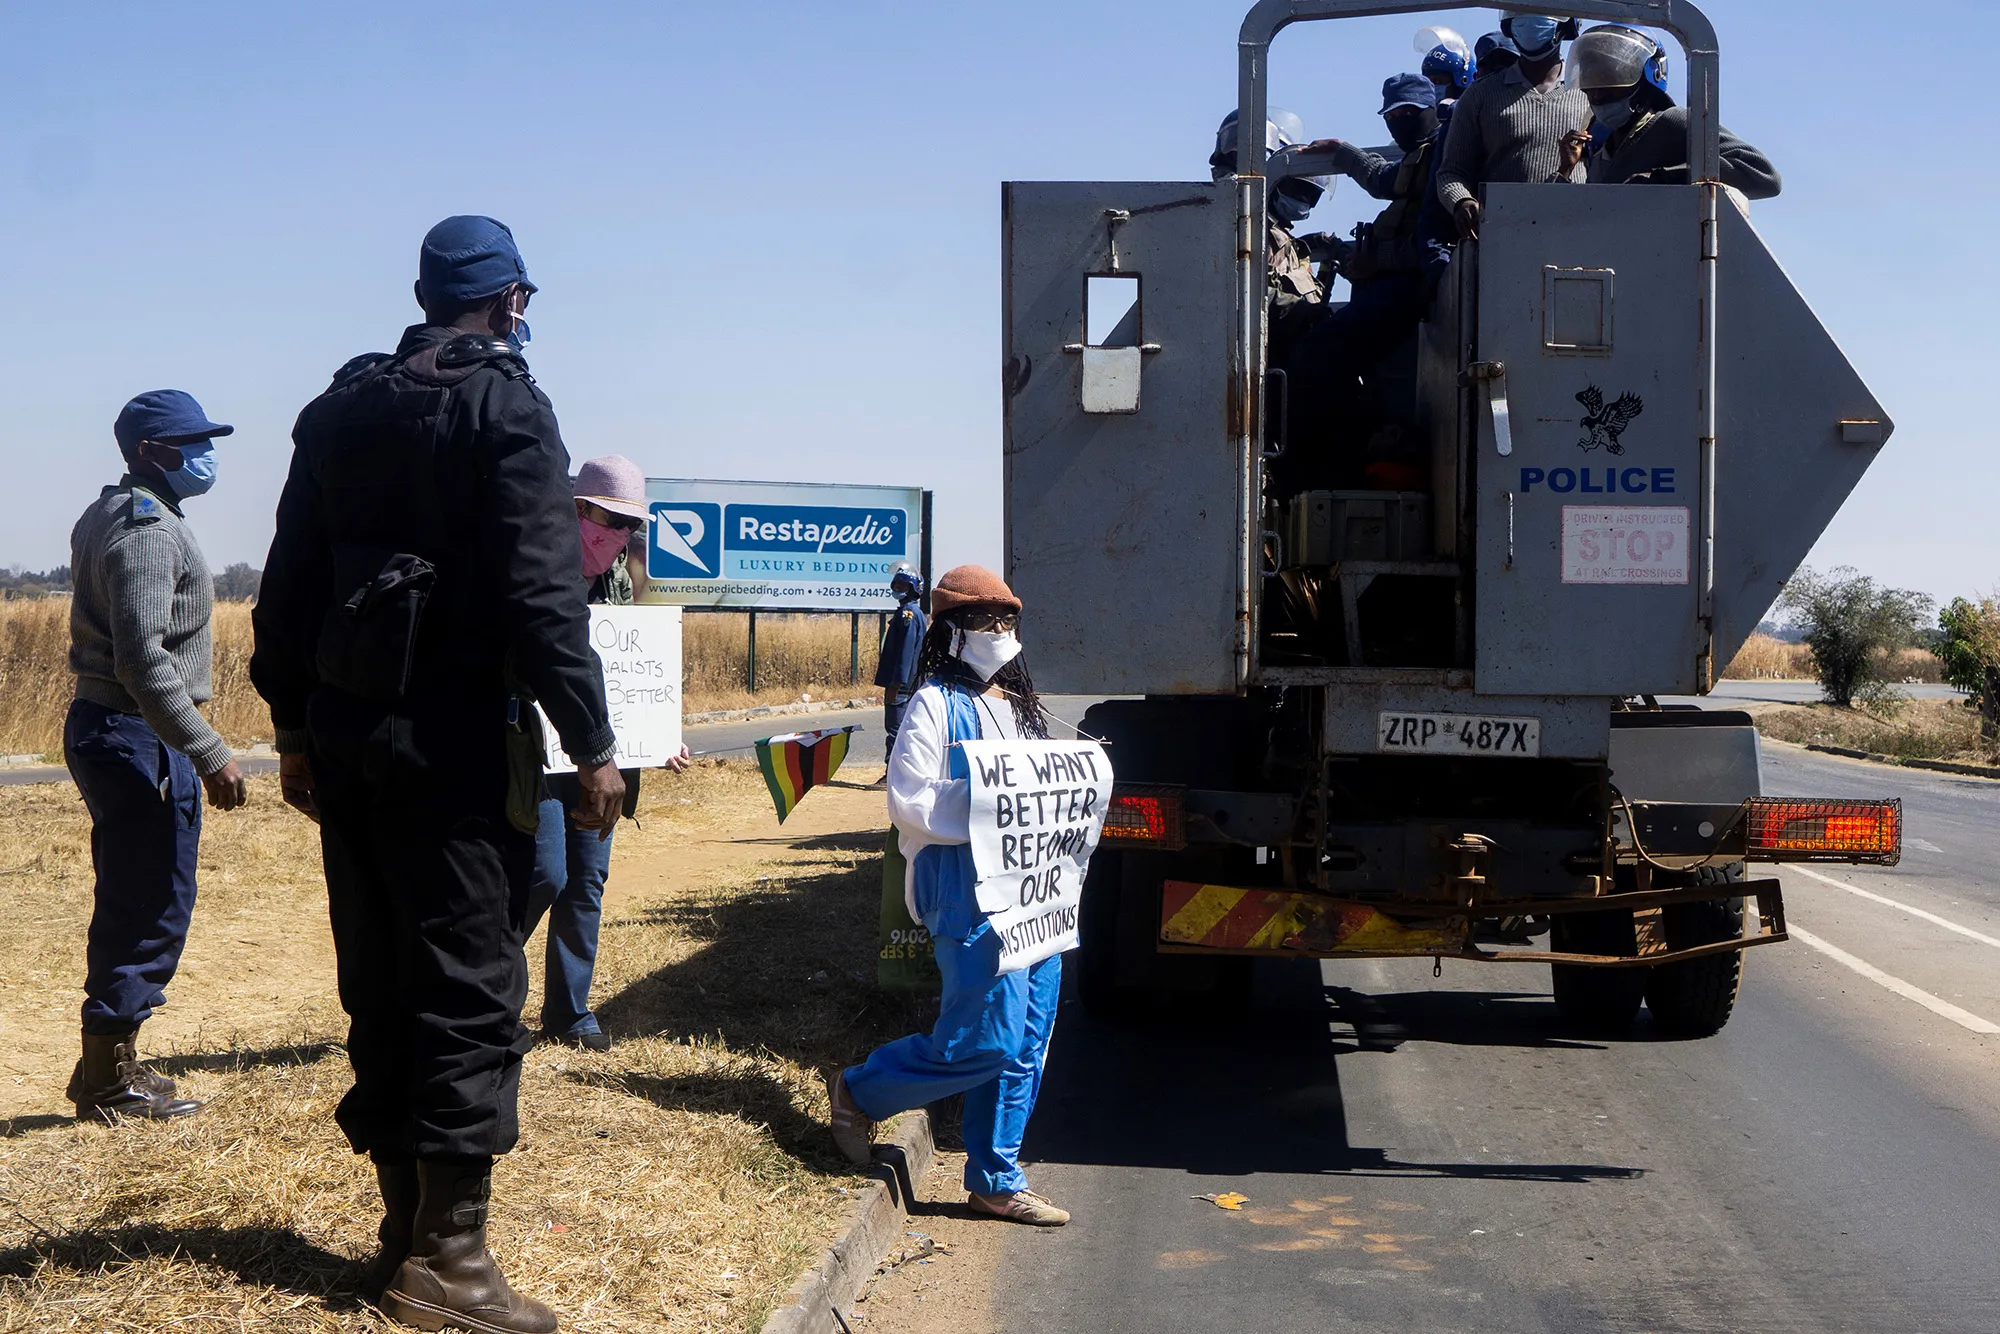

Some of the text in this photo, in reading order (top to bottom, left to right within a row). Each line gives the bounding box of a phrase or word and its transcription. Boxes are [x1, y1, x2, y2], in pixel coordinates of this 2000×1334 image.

[1428, 50, 1447, 62] LICE
[1520, 467, 1676, 493] POLICE
[1579, 529, 1675, 562] STOP
[739, 559, 805, 571] LUXURY
[1576, 567, 1590, 577] AT
[1620, 567, 1683, 578] CROSSINGS
[649, 584, 891, 598] www.restapedicbedding.com +263 24 24475
[596, 619, 643, 652] OUR
[602, 660, 664, 677] NALISTS
[604, 680, 675, 705] BETTER
[1385, 718, 1528, 752] ZRP 487X
[976, 751, 1099, 788] WE WANT
[996, 787, 1099, 828] BETTER
[1002, 826, 1089, 871] REFORM
[1020, 864, 1062, 908] OUR
[890, 929, 928, 944] 2016
[880, 945, 904, 959] SEP
